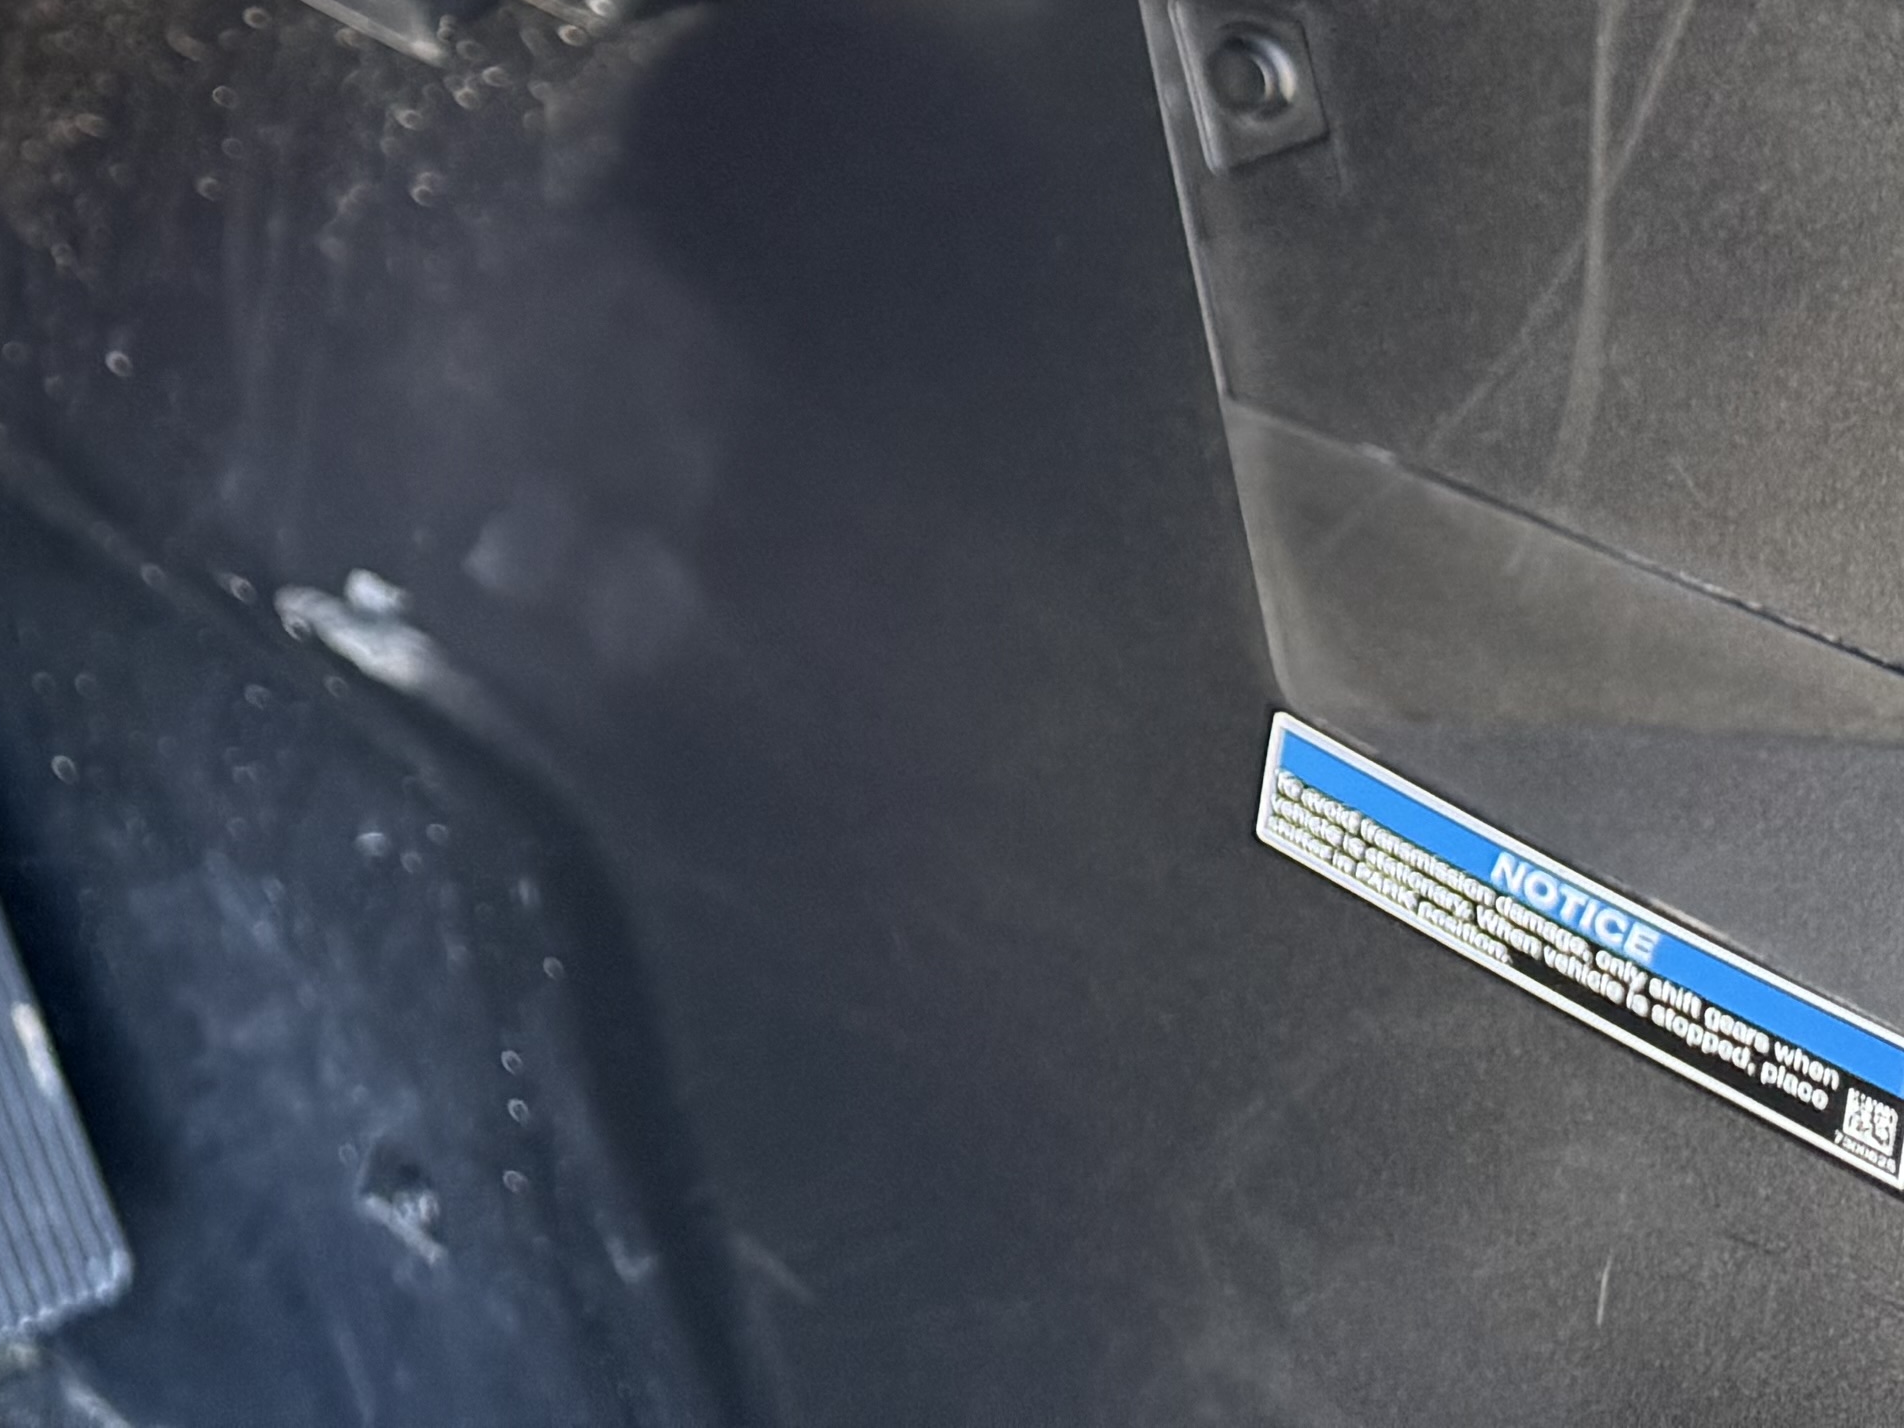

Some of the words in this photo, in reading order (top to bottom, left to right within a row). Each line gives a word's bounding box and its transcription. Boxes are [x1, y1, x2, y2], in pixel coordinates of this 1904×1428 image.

[1355, 863, 1420, 912] PARK
[1418, 899, 1512, 962] position.
[1359, 817, 1497, 906] transmission
[1495, 894, 1593, 962] damage,
[1594, 948, 1648, 996] only
[1649, 975, 1703, 1020] shift
[1704, 1004, 1770, 1055] gears
[1774, 1040, 1840, 1092] when
[1490, 851, 1663, 963] NOTICE
[1474, 904, 1543, 959] When
[1544, 943, 1626, 1005] vehicle
[1626, 989, 1649, 1019] is
[1650, 1001, 1758, 1077] stopped,
[1760, 1059, 1829, 1112] place
